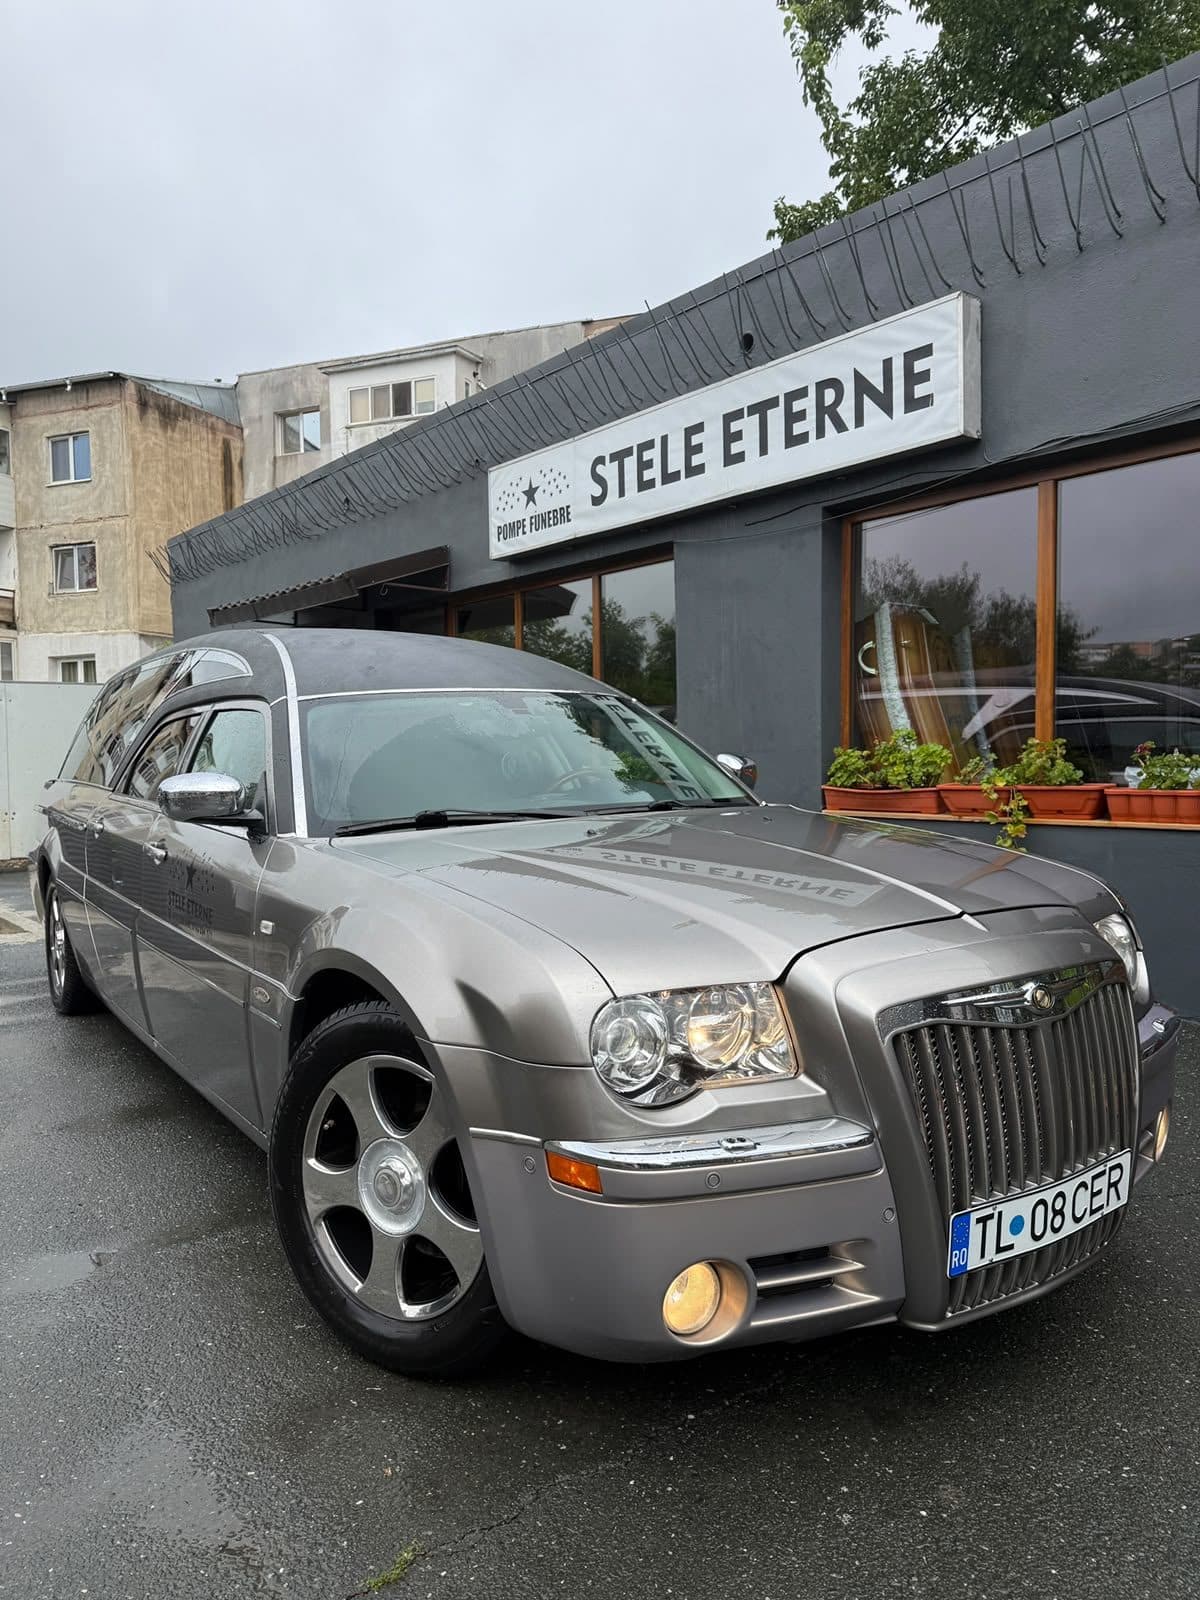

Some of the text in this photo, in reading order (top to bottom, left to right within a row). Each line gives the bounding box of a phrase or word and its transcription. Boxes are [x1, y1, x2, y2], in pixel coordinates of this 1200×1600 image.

[590, 343, 934, 507] STELE ETERNE
[497, 505, 572, 542] POMPE FUNEBRE
[951, 1247, 968, 1269] RO
